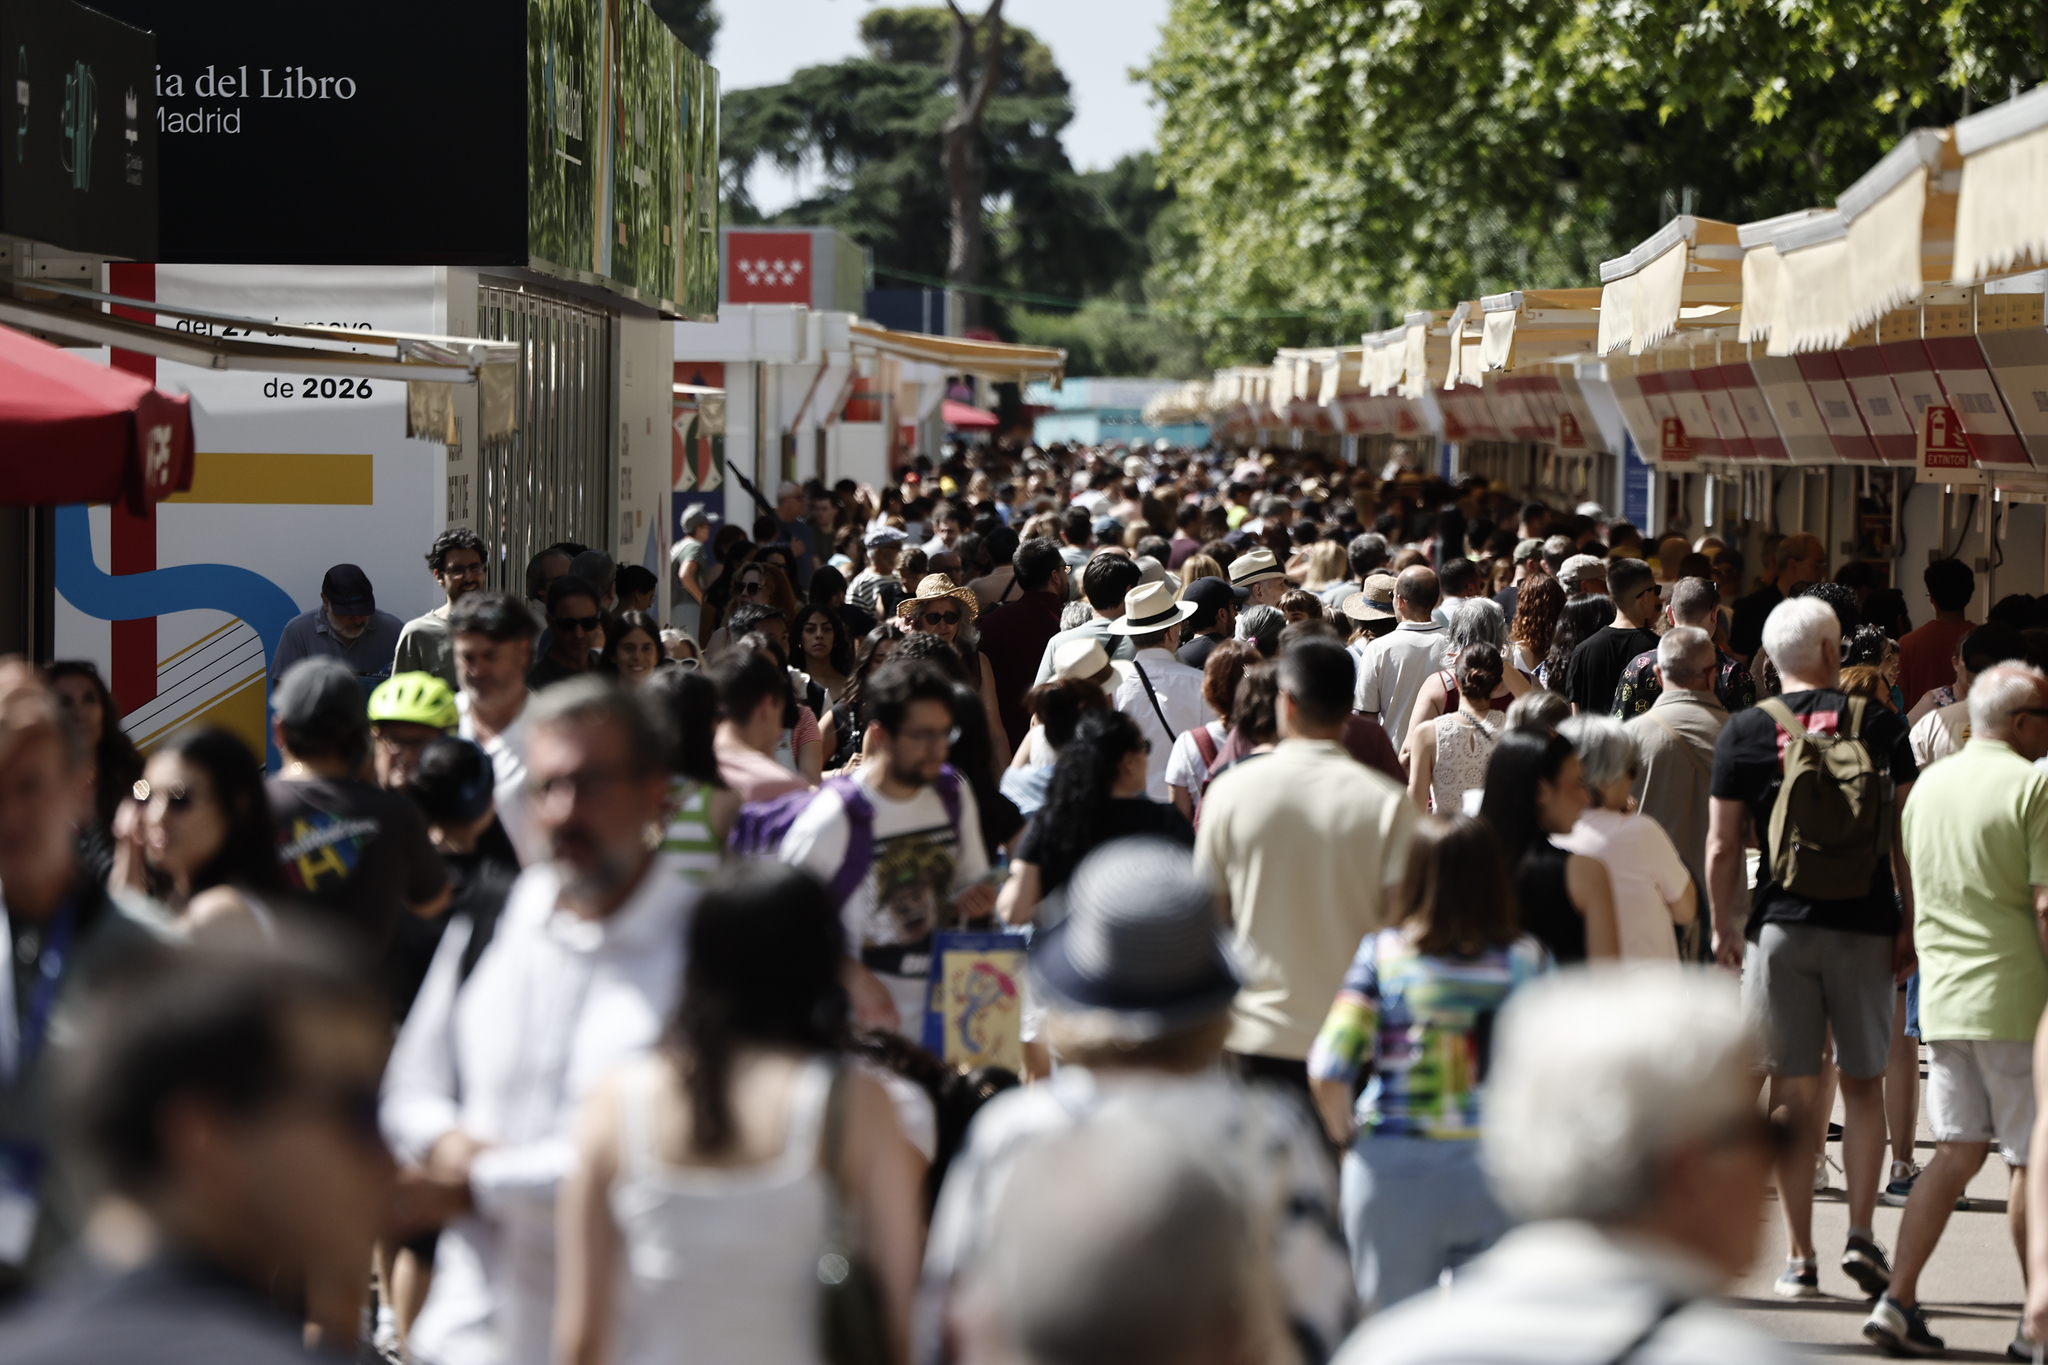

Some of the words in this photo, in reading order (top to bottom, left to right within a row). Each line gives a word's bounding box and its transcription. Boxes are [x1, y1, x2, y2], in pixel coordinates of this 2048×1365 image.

[195, 65, 250, 98] del
[259, 66, 357, 99] Libro
[263, 377, 294, 398] de
[302, 378, 373, 399] 2026
[1927, 454, 1967, 466] EXTINTOR
